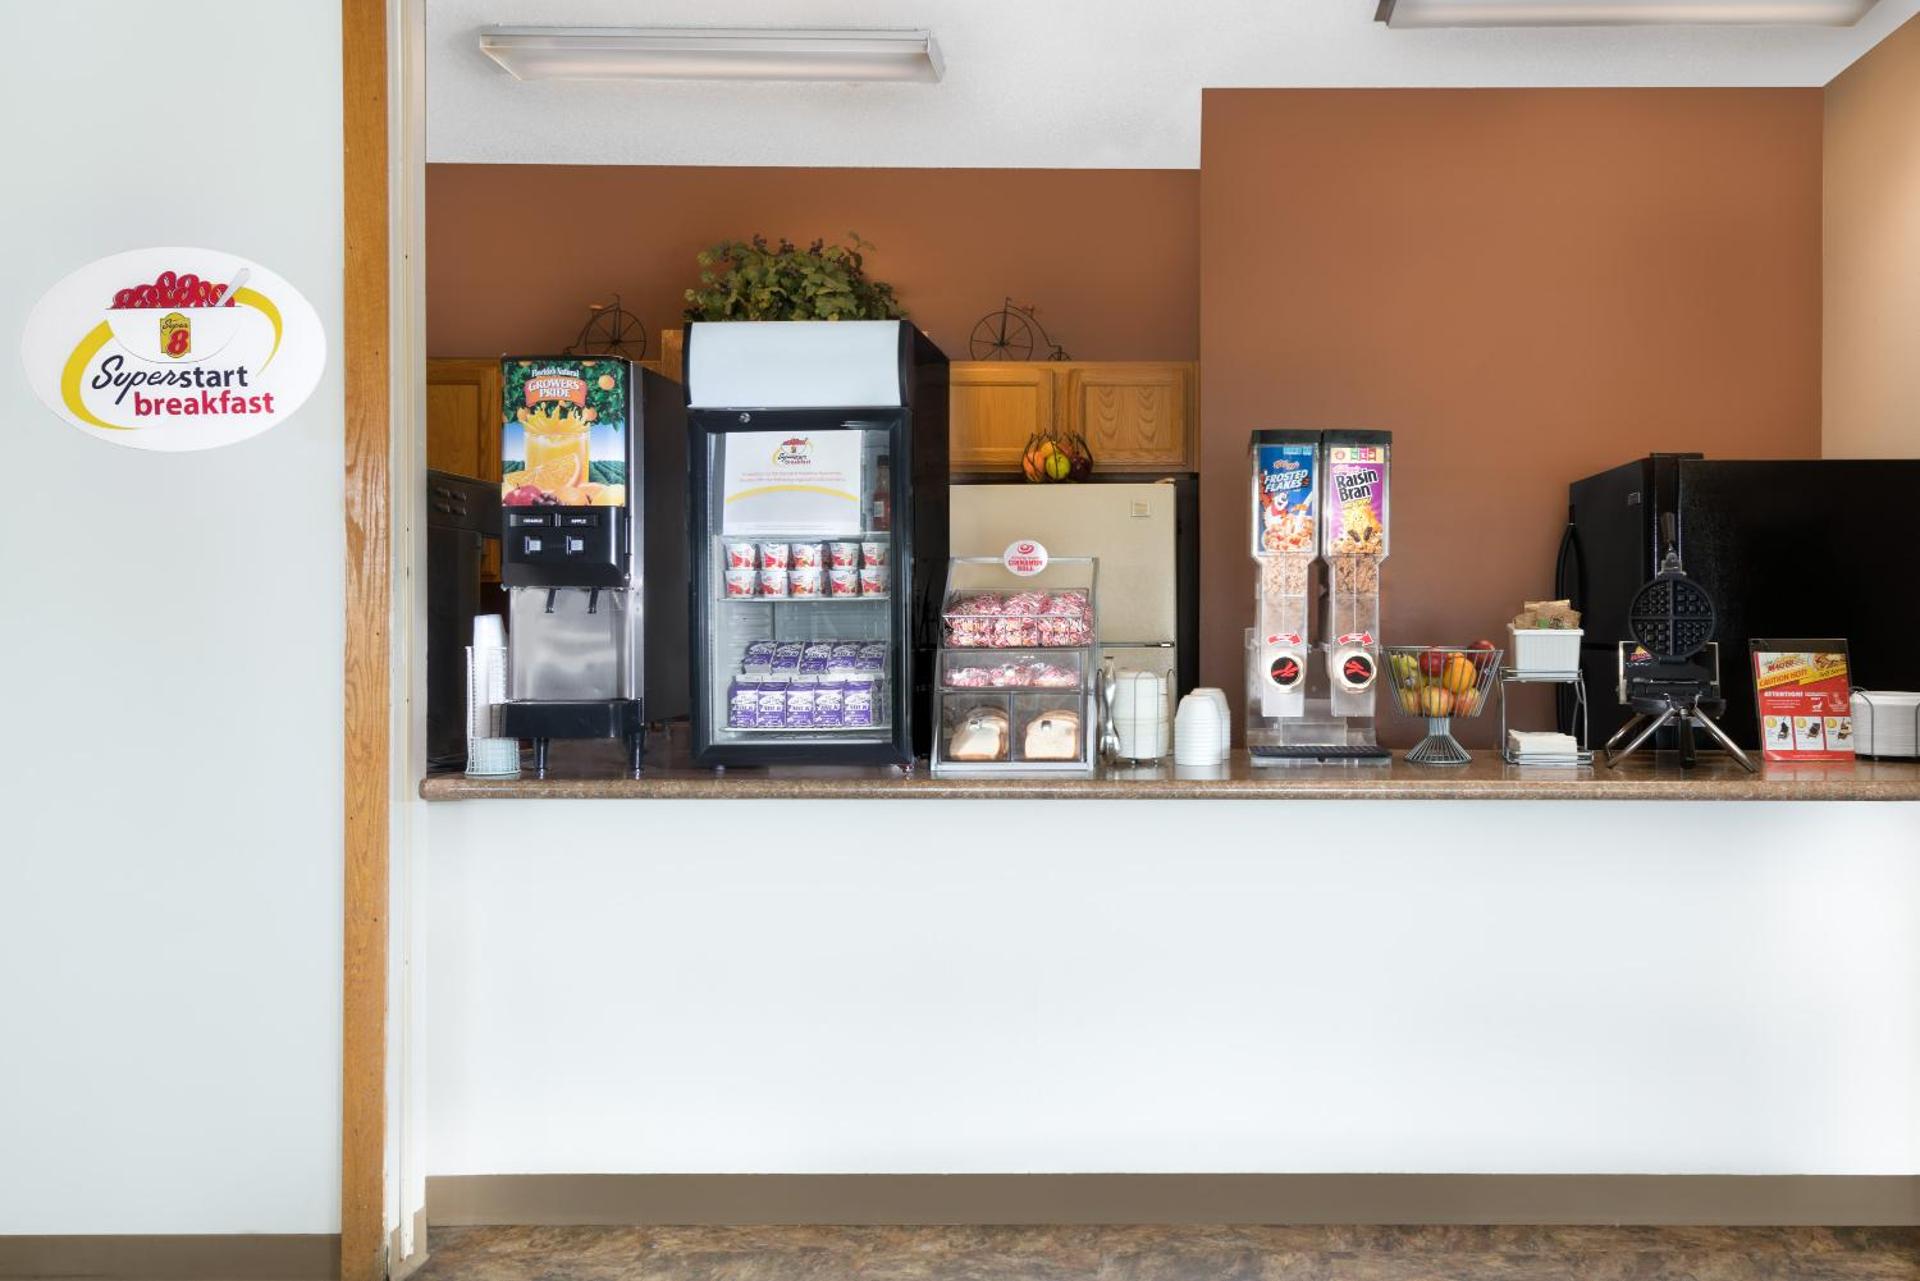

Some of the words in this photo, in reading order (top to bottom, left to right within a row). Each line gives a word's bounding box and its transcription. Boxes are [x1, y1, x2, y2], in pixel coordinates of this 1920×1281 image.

[162, 318, 188, 334] Super
[167, 329, 189, 354] 8
[529, 379, 580, 392] GROWERS
[539, 388, 570, 398] PRIDE
[134, 390, 274, 416] breakfast
[1264, 469, 1309, 485] FROSTED
[1335, 469, 1378, 488] Raisin
[1264, 480, 1302, 493] FLAKES
[1339, 484, 1371, 502] Bran
